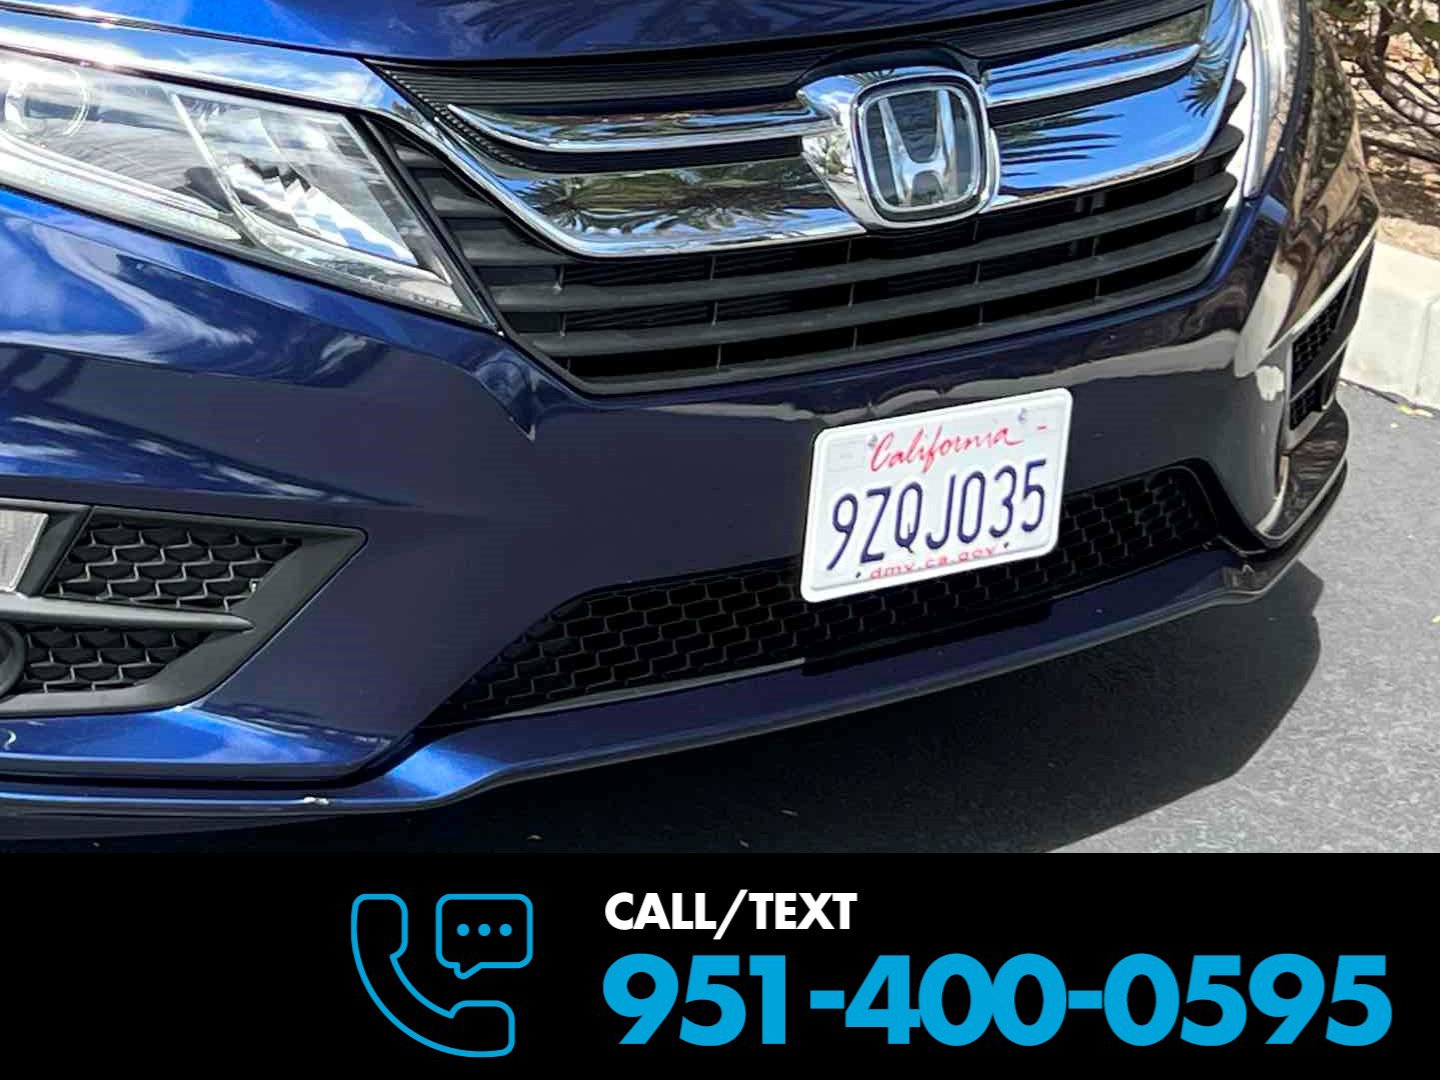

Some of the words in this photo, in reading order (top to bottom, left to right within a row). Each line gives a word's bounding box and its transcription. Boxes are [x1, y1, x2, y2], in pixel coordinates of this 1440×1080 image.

[869, 423, 1024, 473] California
[826, 458, 1047, 571] 9ZQJ035
[869, 544, 998, 581] dmv.ca.gov
